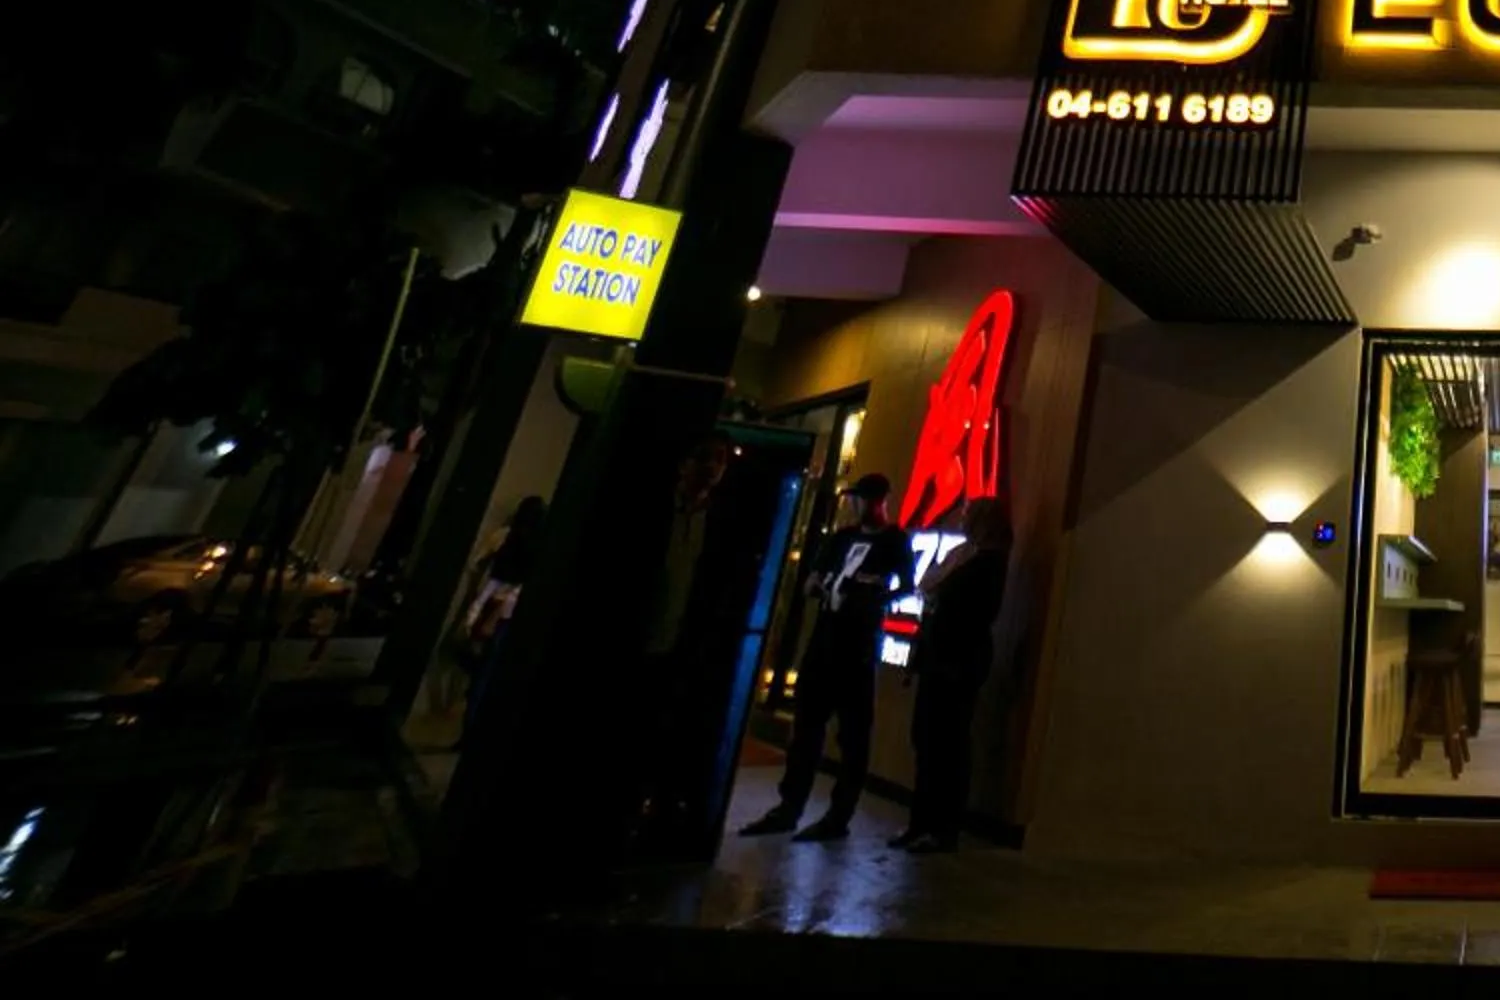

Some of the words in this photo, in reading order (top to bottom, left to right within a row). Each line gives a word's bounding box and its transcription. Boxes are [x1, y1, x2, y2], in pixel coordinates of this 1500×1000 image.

[1047, 89, 1171, 122] 04-611
[1182, 93, 1274, 124] 6189
[559, 222, 618, 258] AUTO
[621, 234, 662, 269] PAY
[553, 263, 642, 307] STATION
